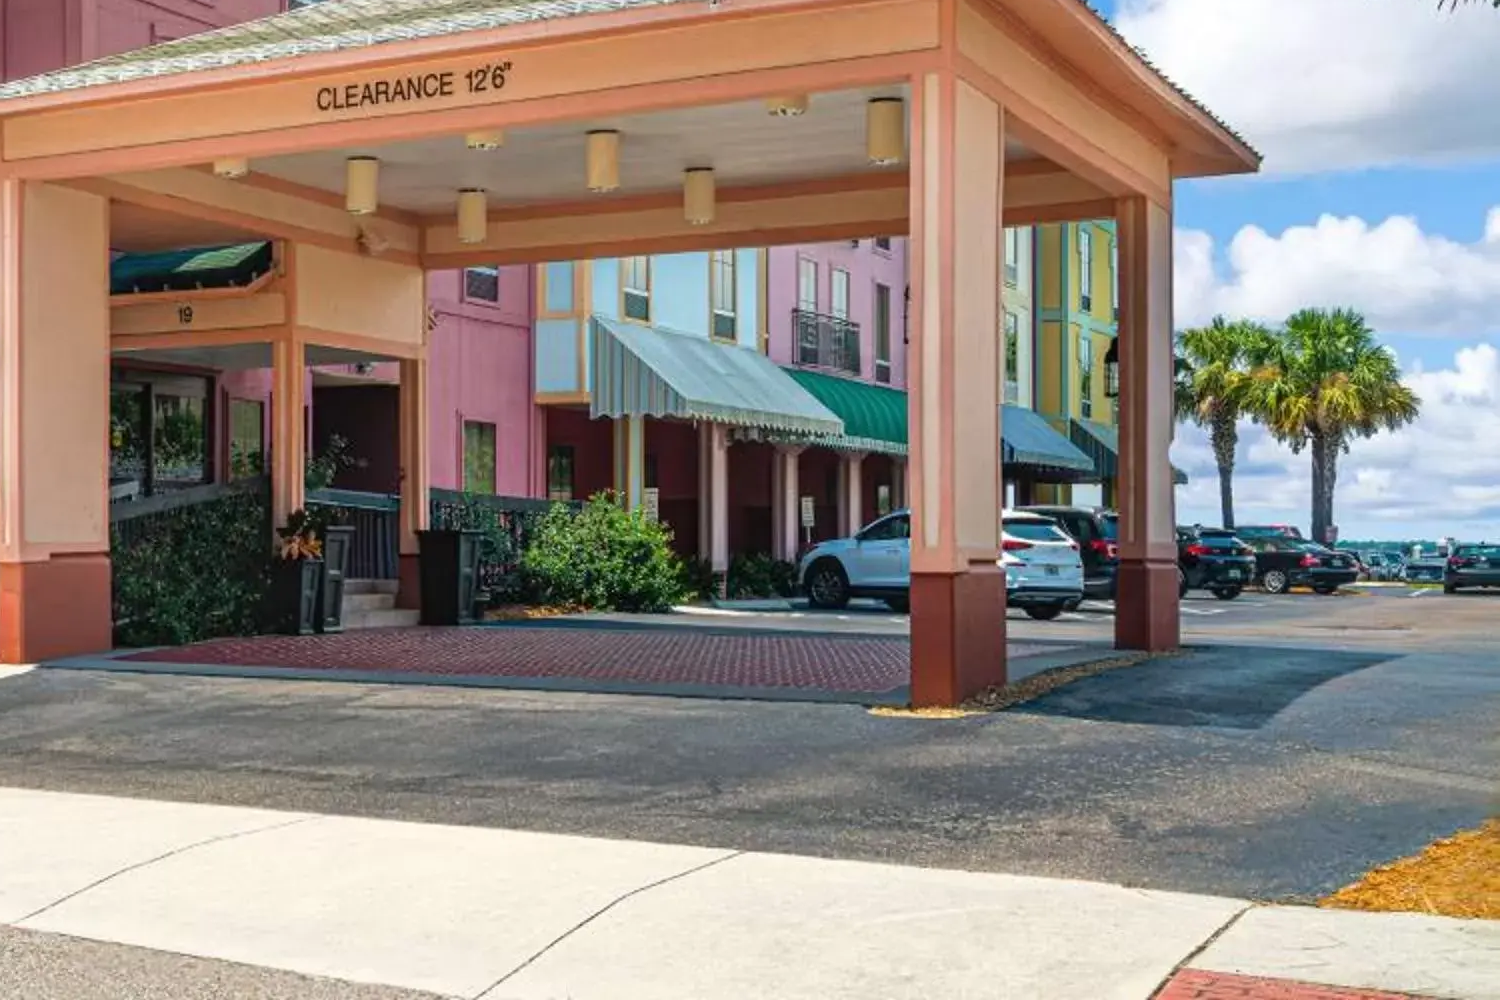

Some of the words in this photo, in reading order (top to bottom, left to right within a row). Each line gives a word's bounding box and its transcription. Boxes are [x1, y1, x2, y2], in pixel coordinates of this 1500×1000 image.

[316, 72, 454, 111] CLEARANCE
[464, 61, 514, 93] 12'6"
[179, 306, 193, 324] 19
